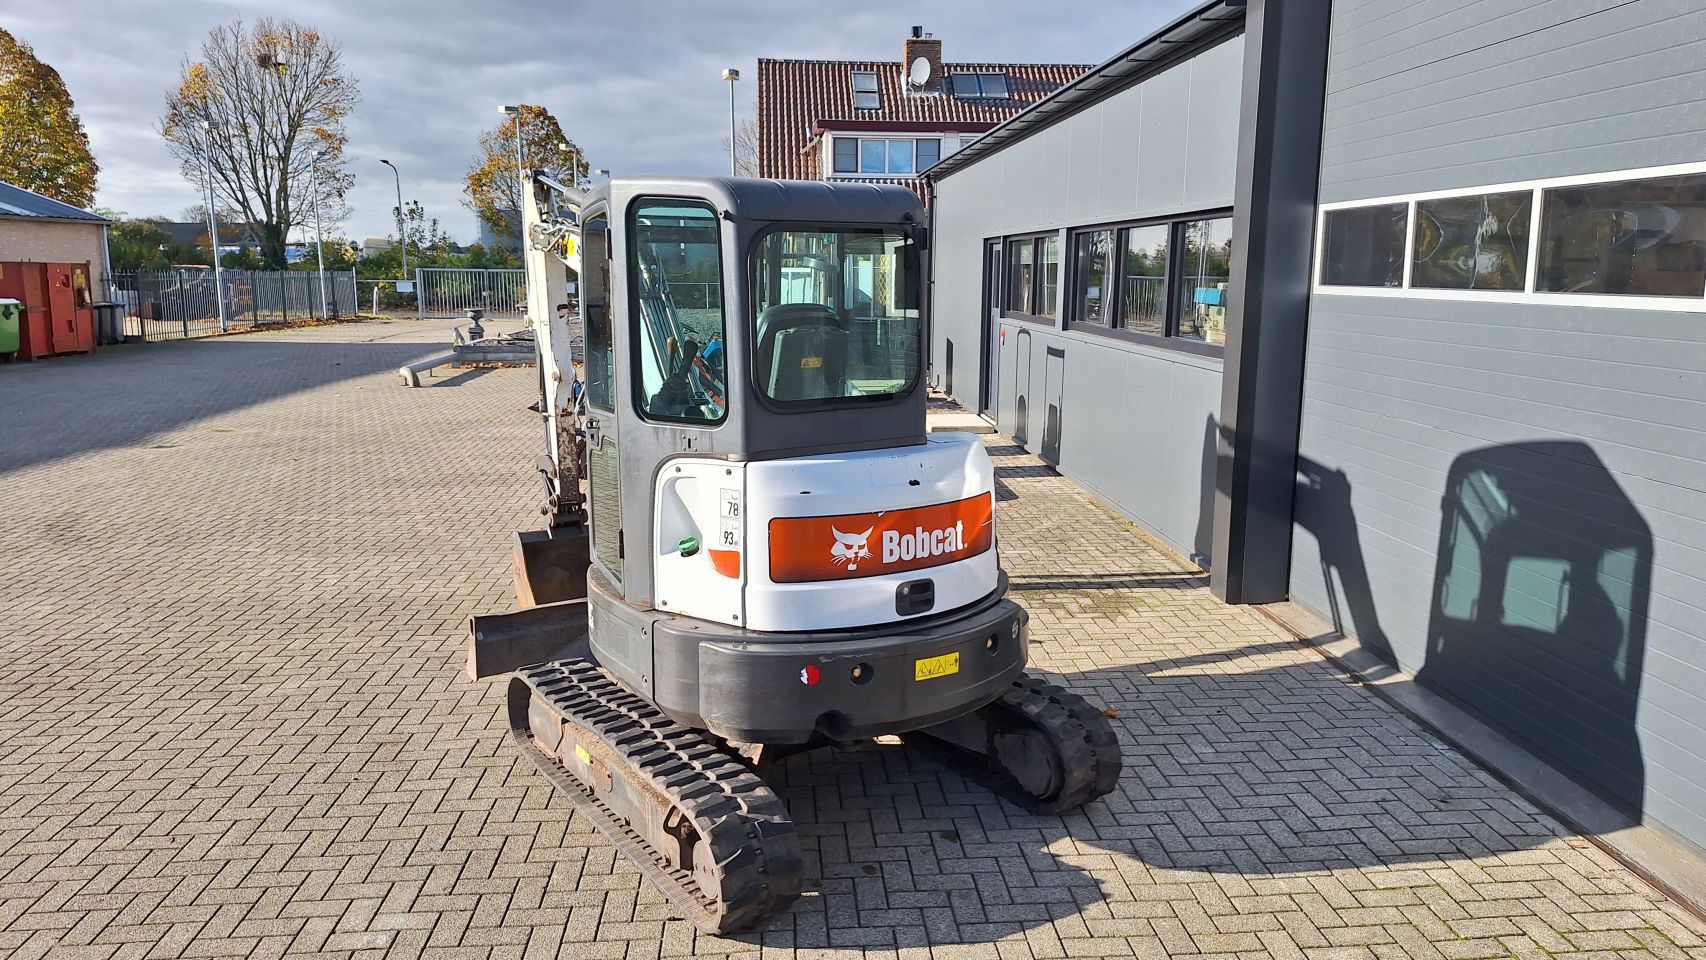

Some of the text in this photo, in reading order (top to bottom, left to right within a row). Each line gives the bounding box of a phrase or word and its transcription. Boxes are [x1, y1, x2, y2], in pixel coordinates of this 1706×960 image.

[727, 501, 739, 517] 78
[723, 530, 734, 546] 93
[882, 520, 964, 564] Bobcat
